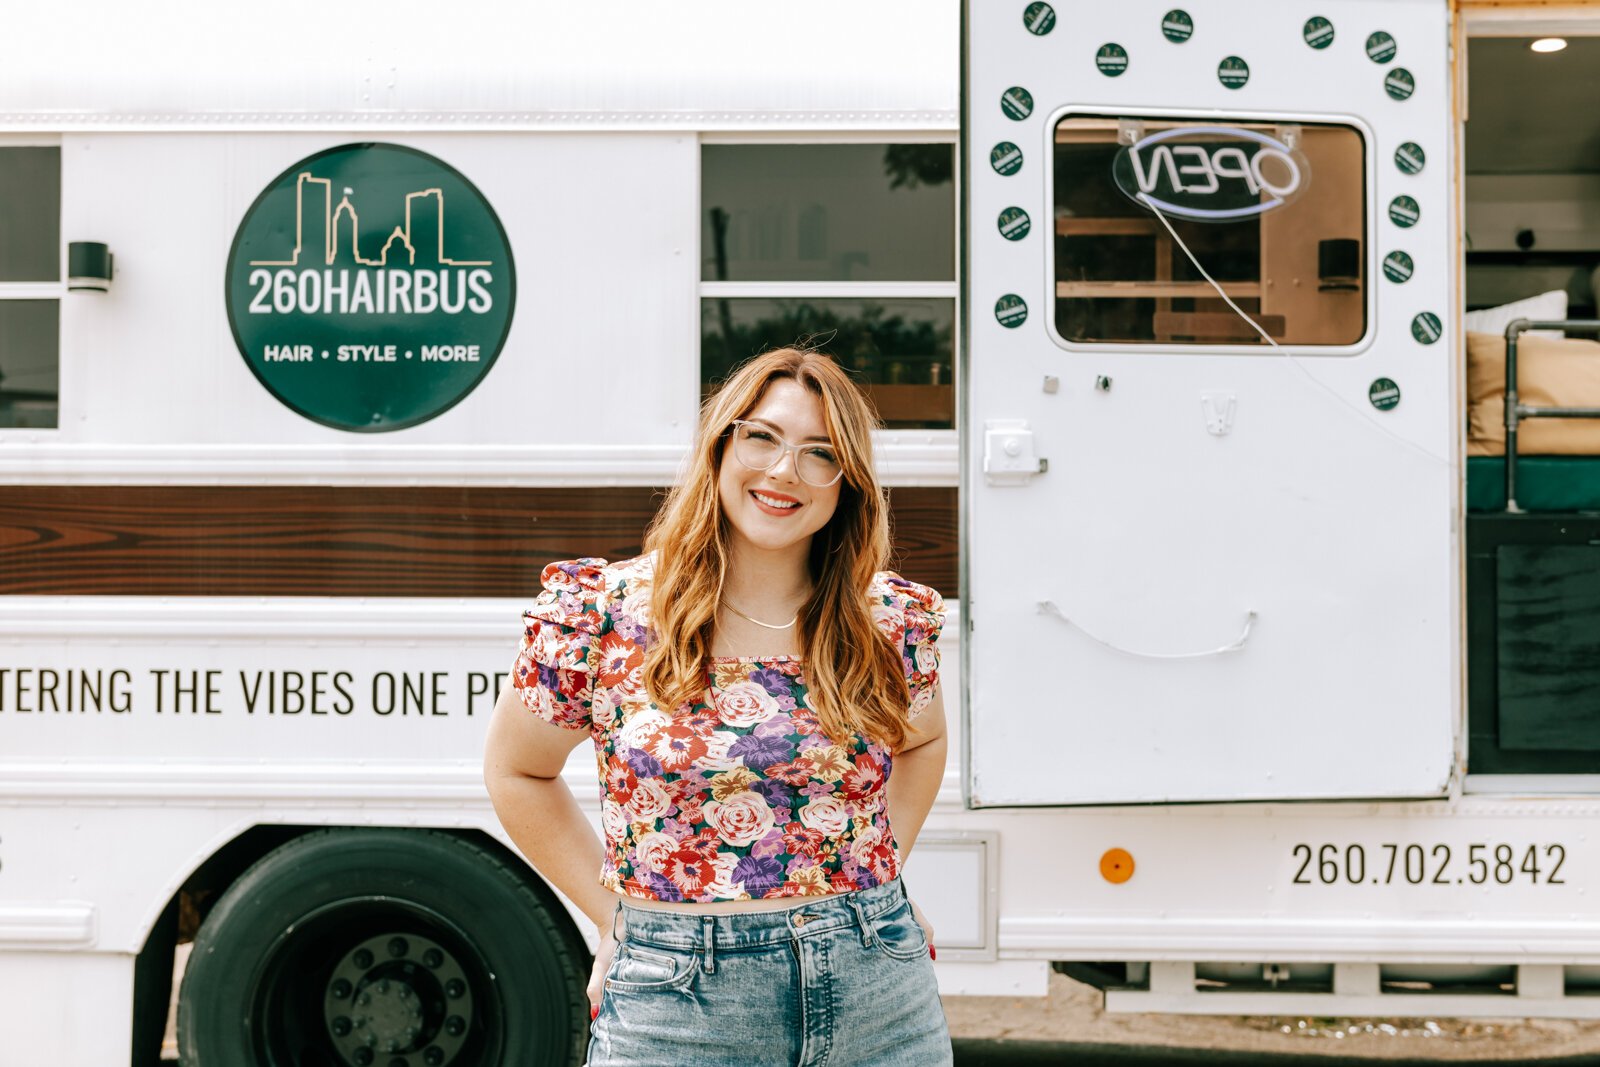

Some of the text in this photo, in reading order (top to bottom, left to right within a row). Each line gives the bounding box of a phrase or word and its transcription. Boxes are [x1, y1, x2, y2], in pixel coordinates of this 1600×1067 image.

[248, 268, 493, 314] 260HAIRBUS
[264, 345, 480, 362] HAIR STYLE MORE
[149, 670, 222, 714] THE
[239, 671, 354, 715] VIBES
[372, 671, 449, 716] ONE
[1292, 843, 1566, 885] 260.702.5842
